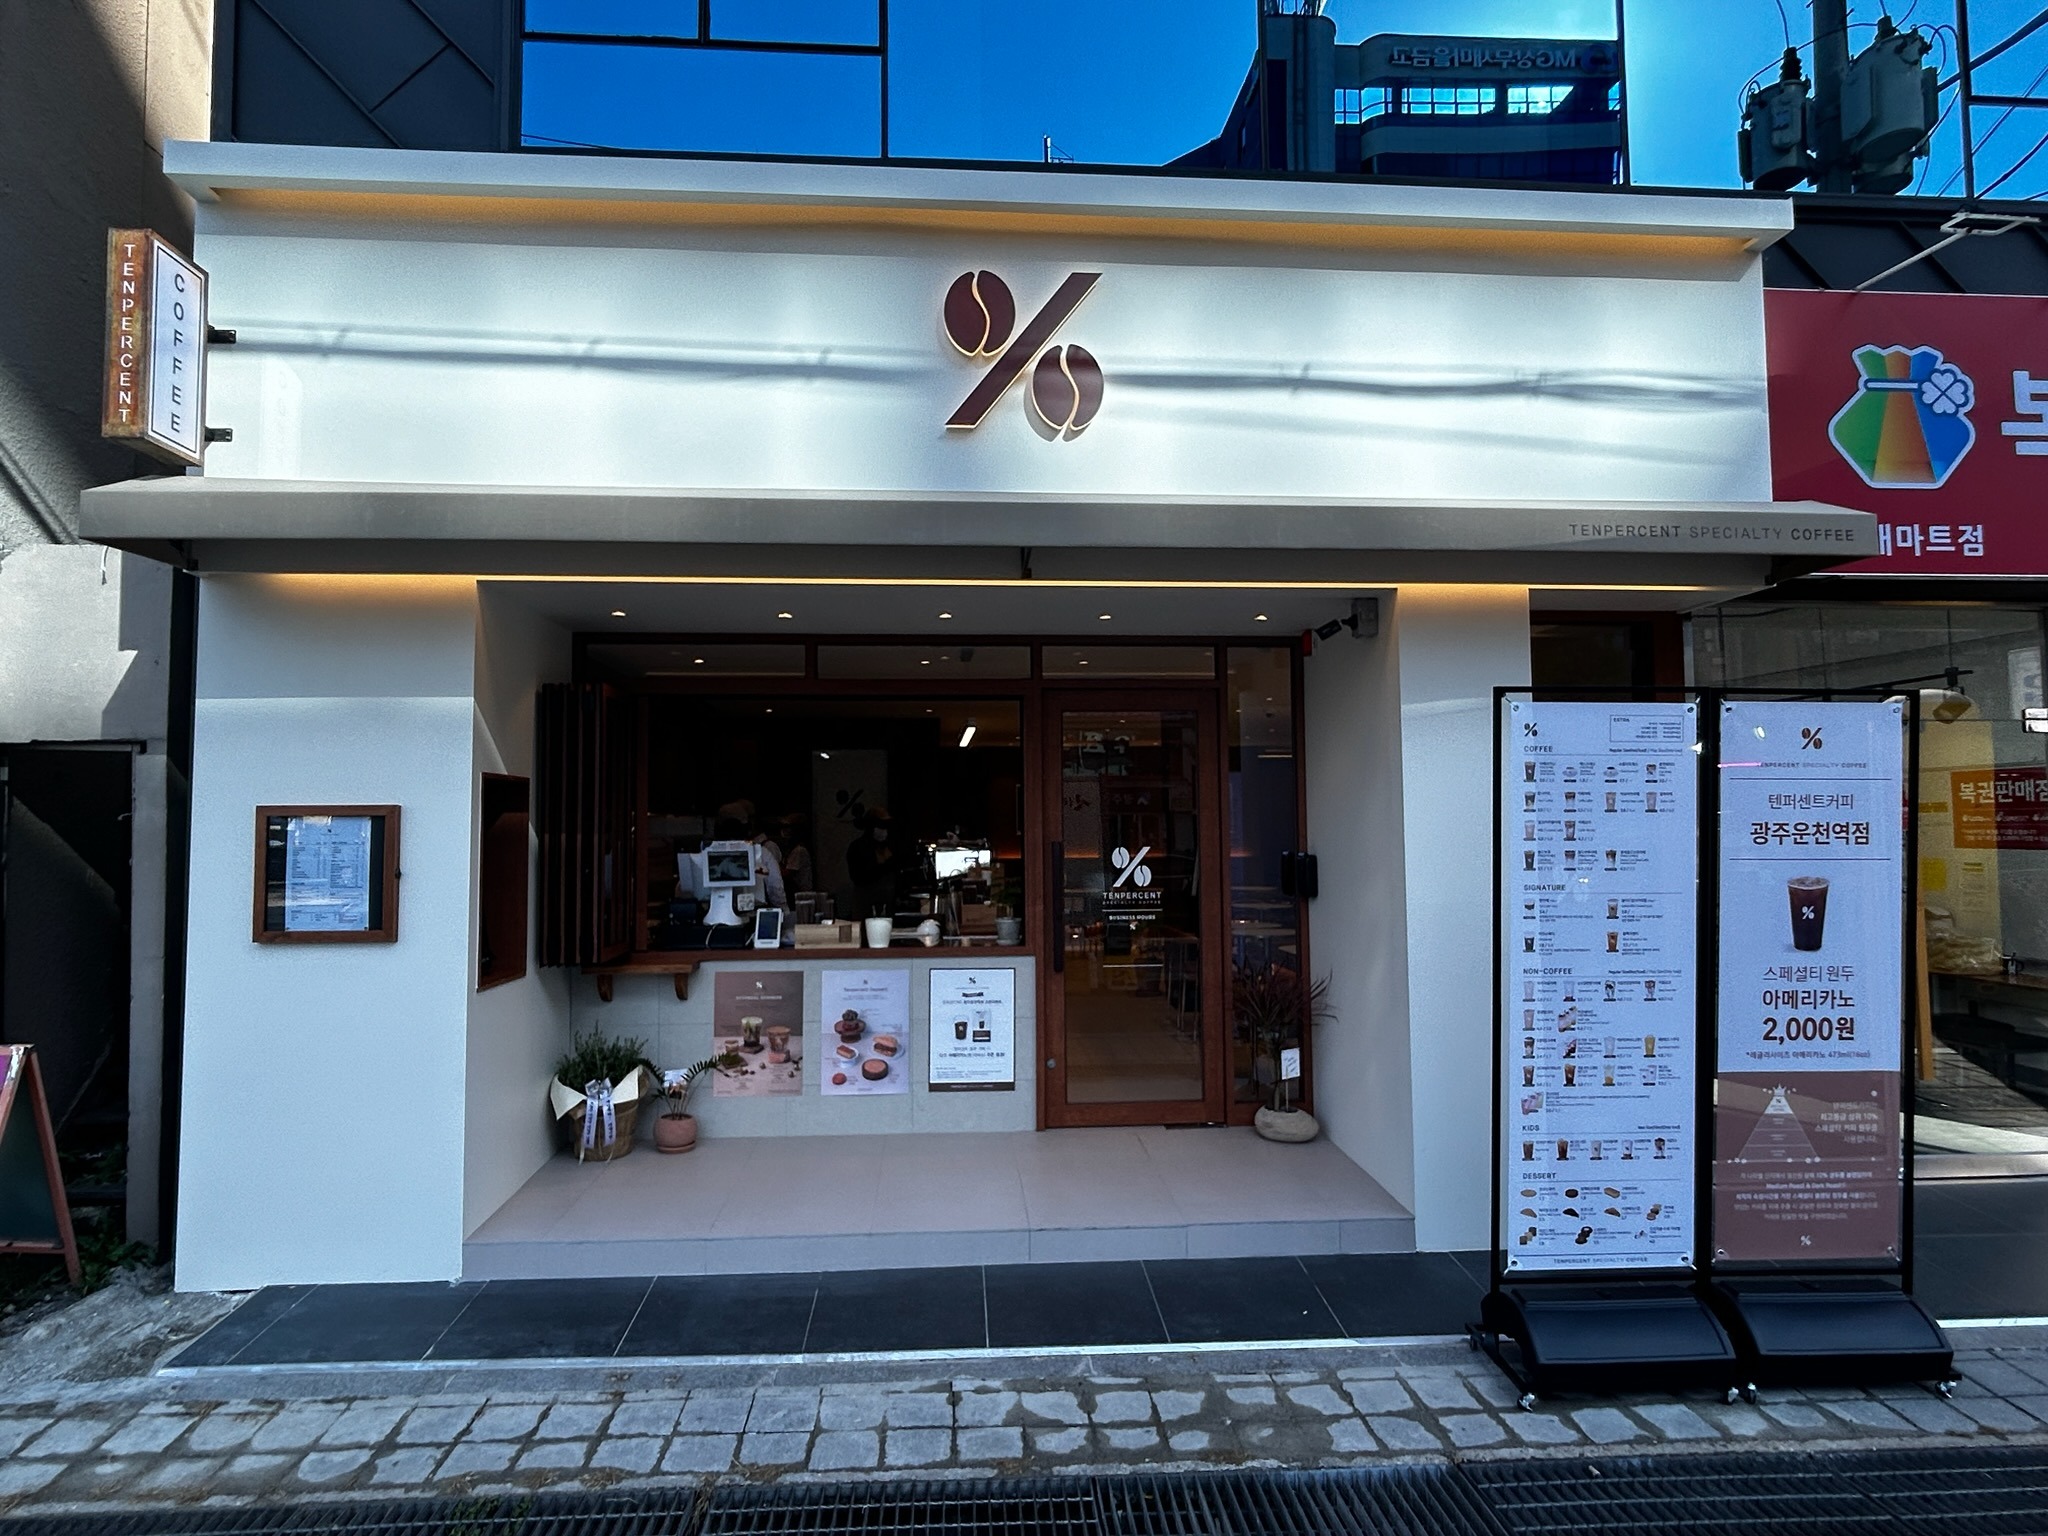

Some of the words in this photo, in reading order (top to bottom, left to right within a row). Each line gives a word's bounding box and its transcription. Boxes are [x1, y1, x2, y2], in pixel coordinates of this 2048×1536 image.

[118, 243, 136, 423] TENPERCENT
[170, 273, 186, 434] COFFEE
[1568, 523, 1681, 538] TENPERCENT
[1689, 526, 1783, 541] SPECIALTY
[1790, 528, 1855, 542] COFFEE
[1523, 745, 1553, 753] COFFEE
[1768, 793, 1854, 810] 텐퍼센트커피
[1750, 821, 1871, 846] 광주운천역점
[1102, 891, 1162, 900] TENPERCENT
[1523, 884, 1567, 892] SIGNATURE
[1523, 967, 1573, 975] NON-COFFEE
[1762, 965, 1823, 983] 스페셜티
[1826, 965, 1855, 982] 원두
[1762, 989, 1856, 1010] 아메리카노
[1762, 1016, 1856, 1046] 2,000원
[1522, 1124, 1540, 1132] KIDS
[1522, 1172, 1557, 1180] DESSERT
